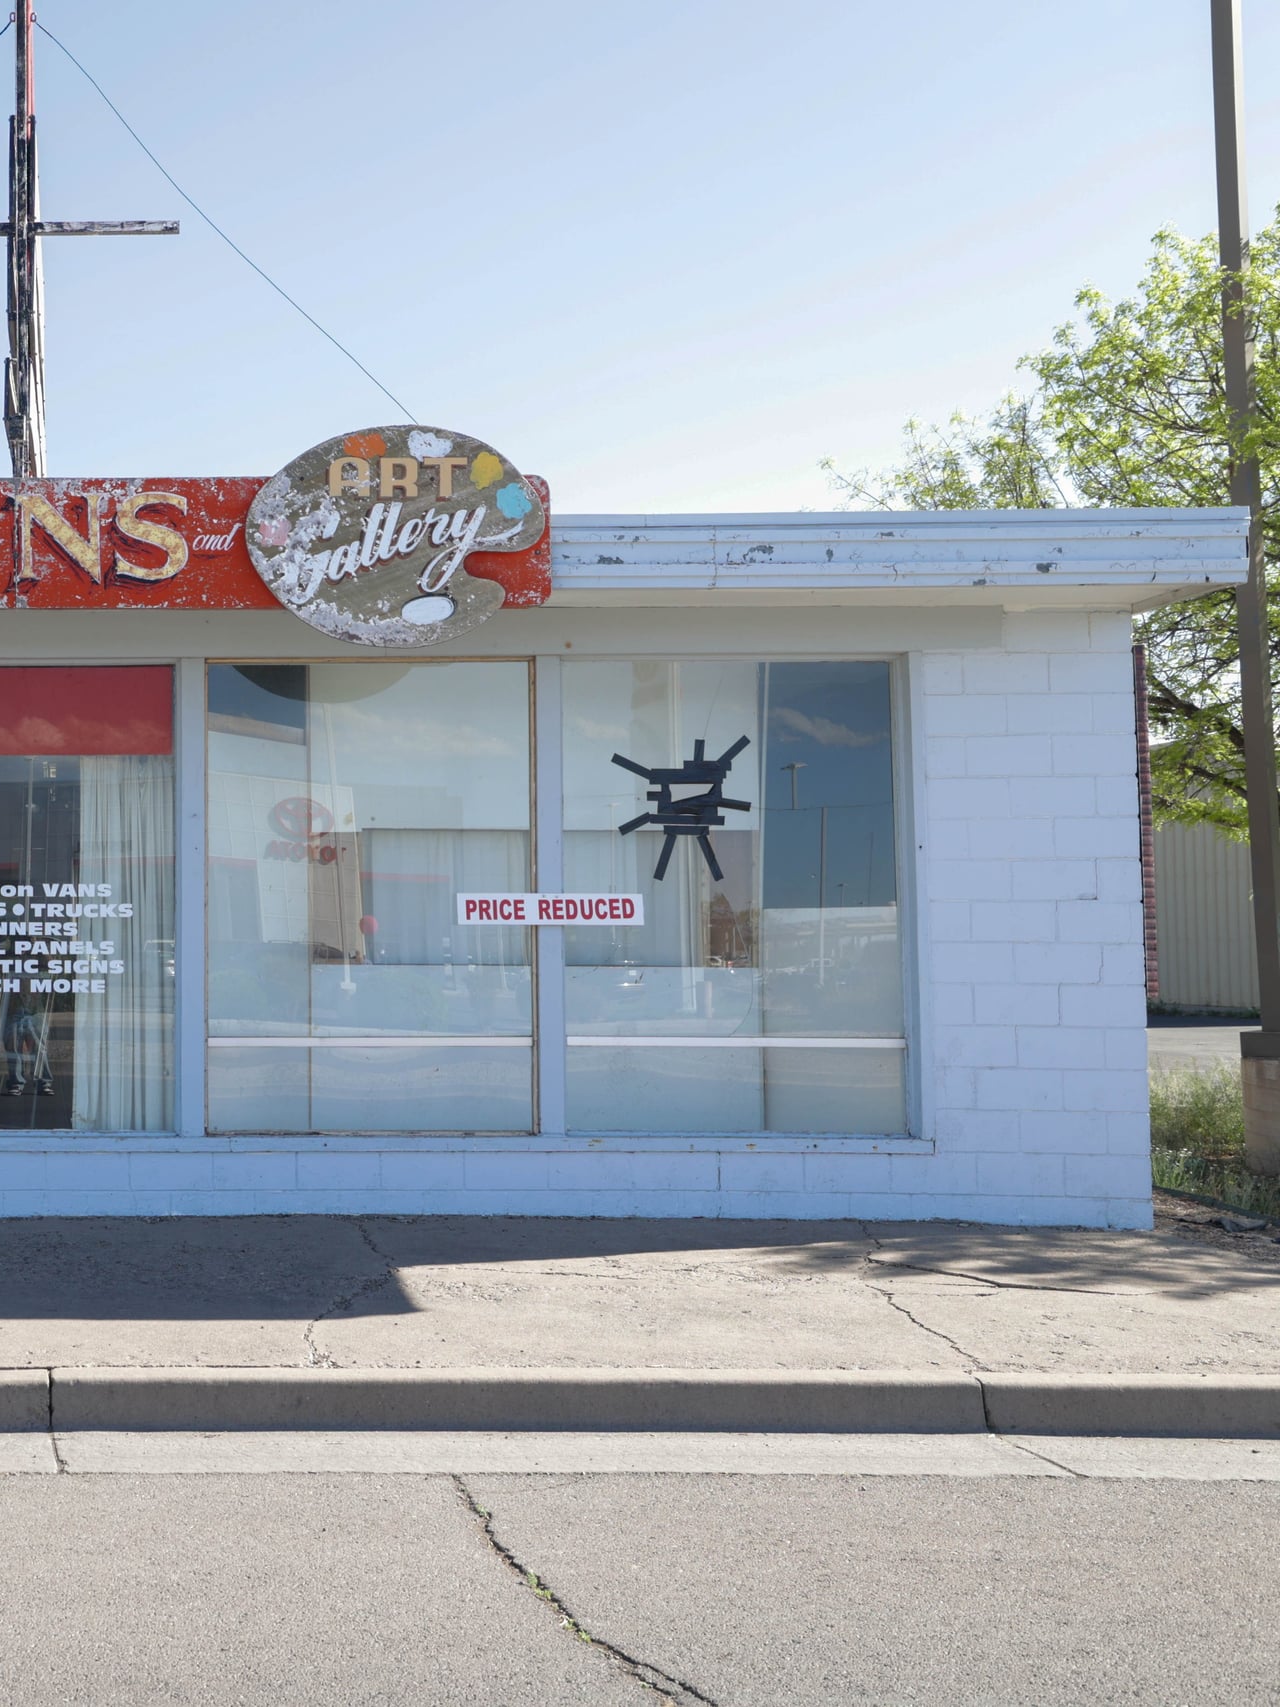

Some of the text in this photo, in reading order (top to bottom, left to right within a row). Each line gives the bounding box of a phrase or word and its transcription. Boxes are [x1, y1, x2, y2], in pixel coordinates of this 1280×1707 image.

[328, 456, 469, 499] ART
[192, 523, 243, 552] and
[273, 501, 523, 605] Gallery
[0, 885, 34, 898] on
[42, 883, 112, 898] VANS
[30, 903, 134, 918] TRUCKS
[465, 898, 635, 921] PRICE REDUCED
[15, 941, 116, 956] PANELS
[47, 959, 125, 975] SIGNS
[30, 978, 106, 993] MORE
